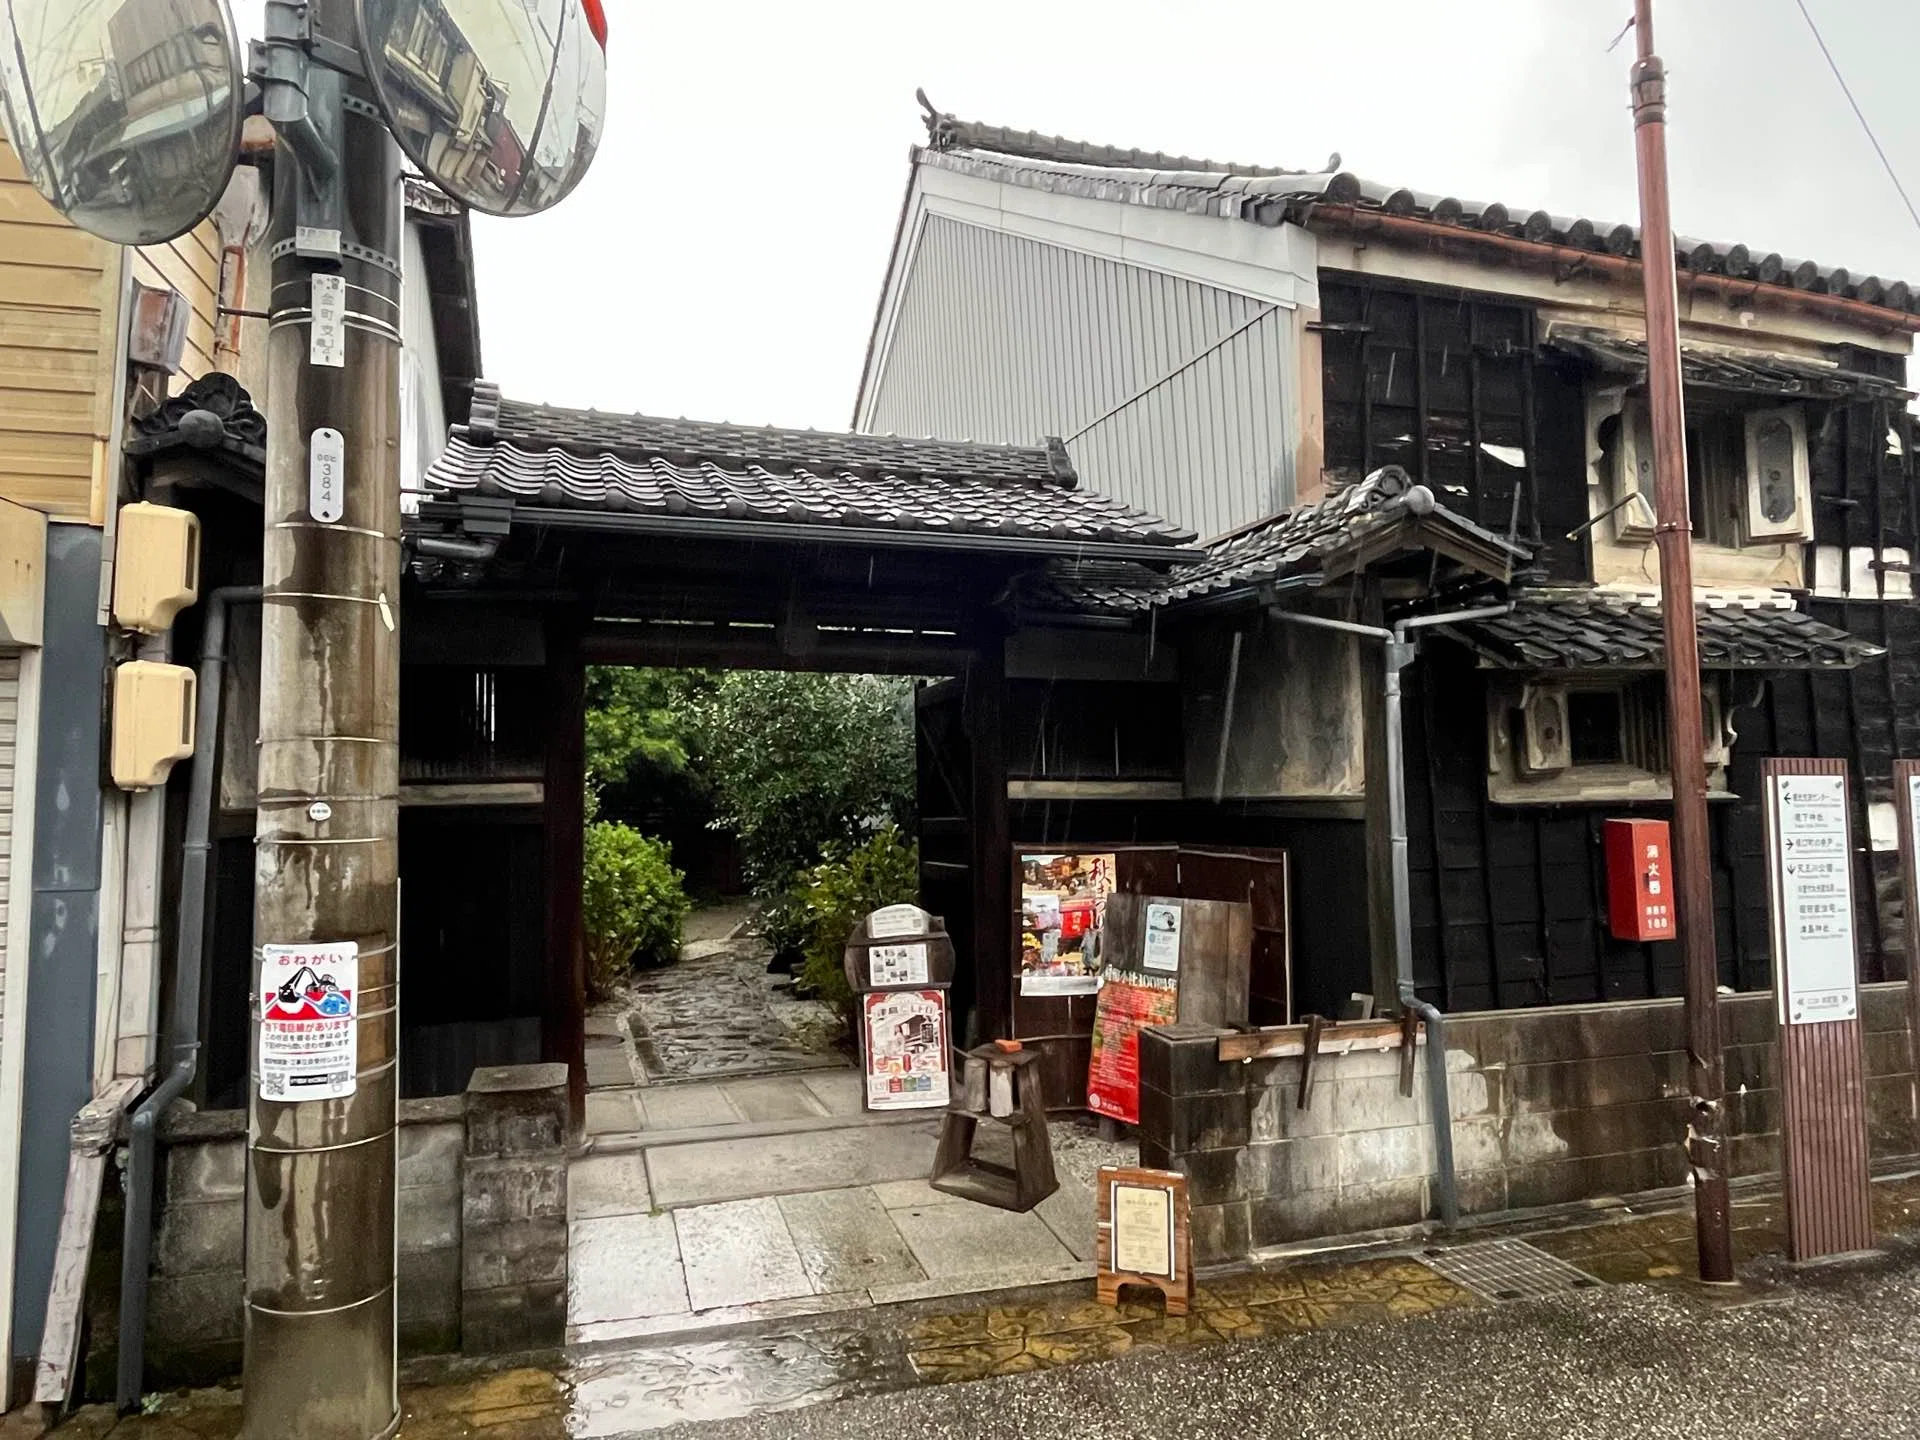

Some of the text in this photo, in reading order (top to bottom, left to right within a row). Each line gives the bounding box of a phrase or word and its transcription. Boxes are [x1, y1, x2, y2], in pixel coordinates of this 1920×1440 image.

[321, 463, 332, 501] 384
[278, 954, 343, 966] おねがい
[264, 1021, 349, 1033] 地下電話線があります
